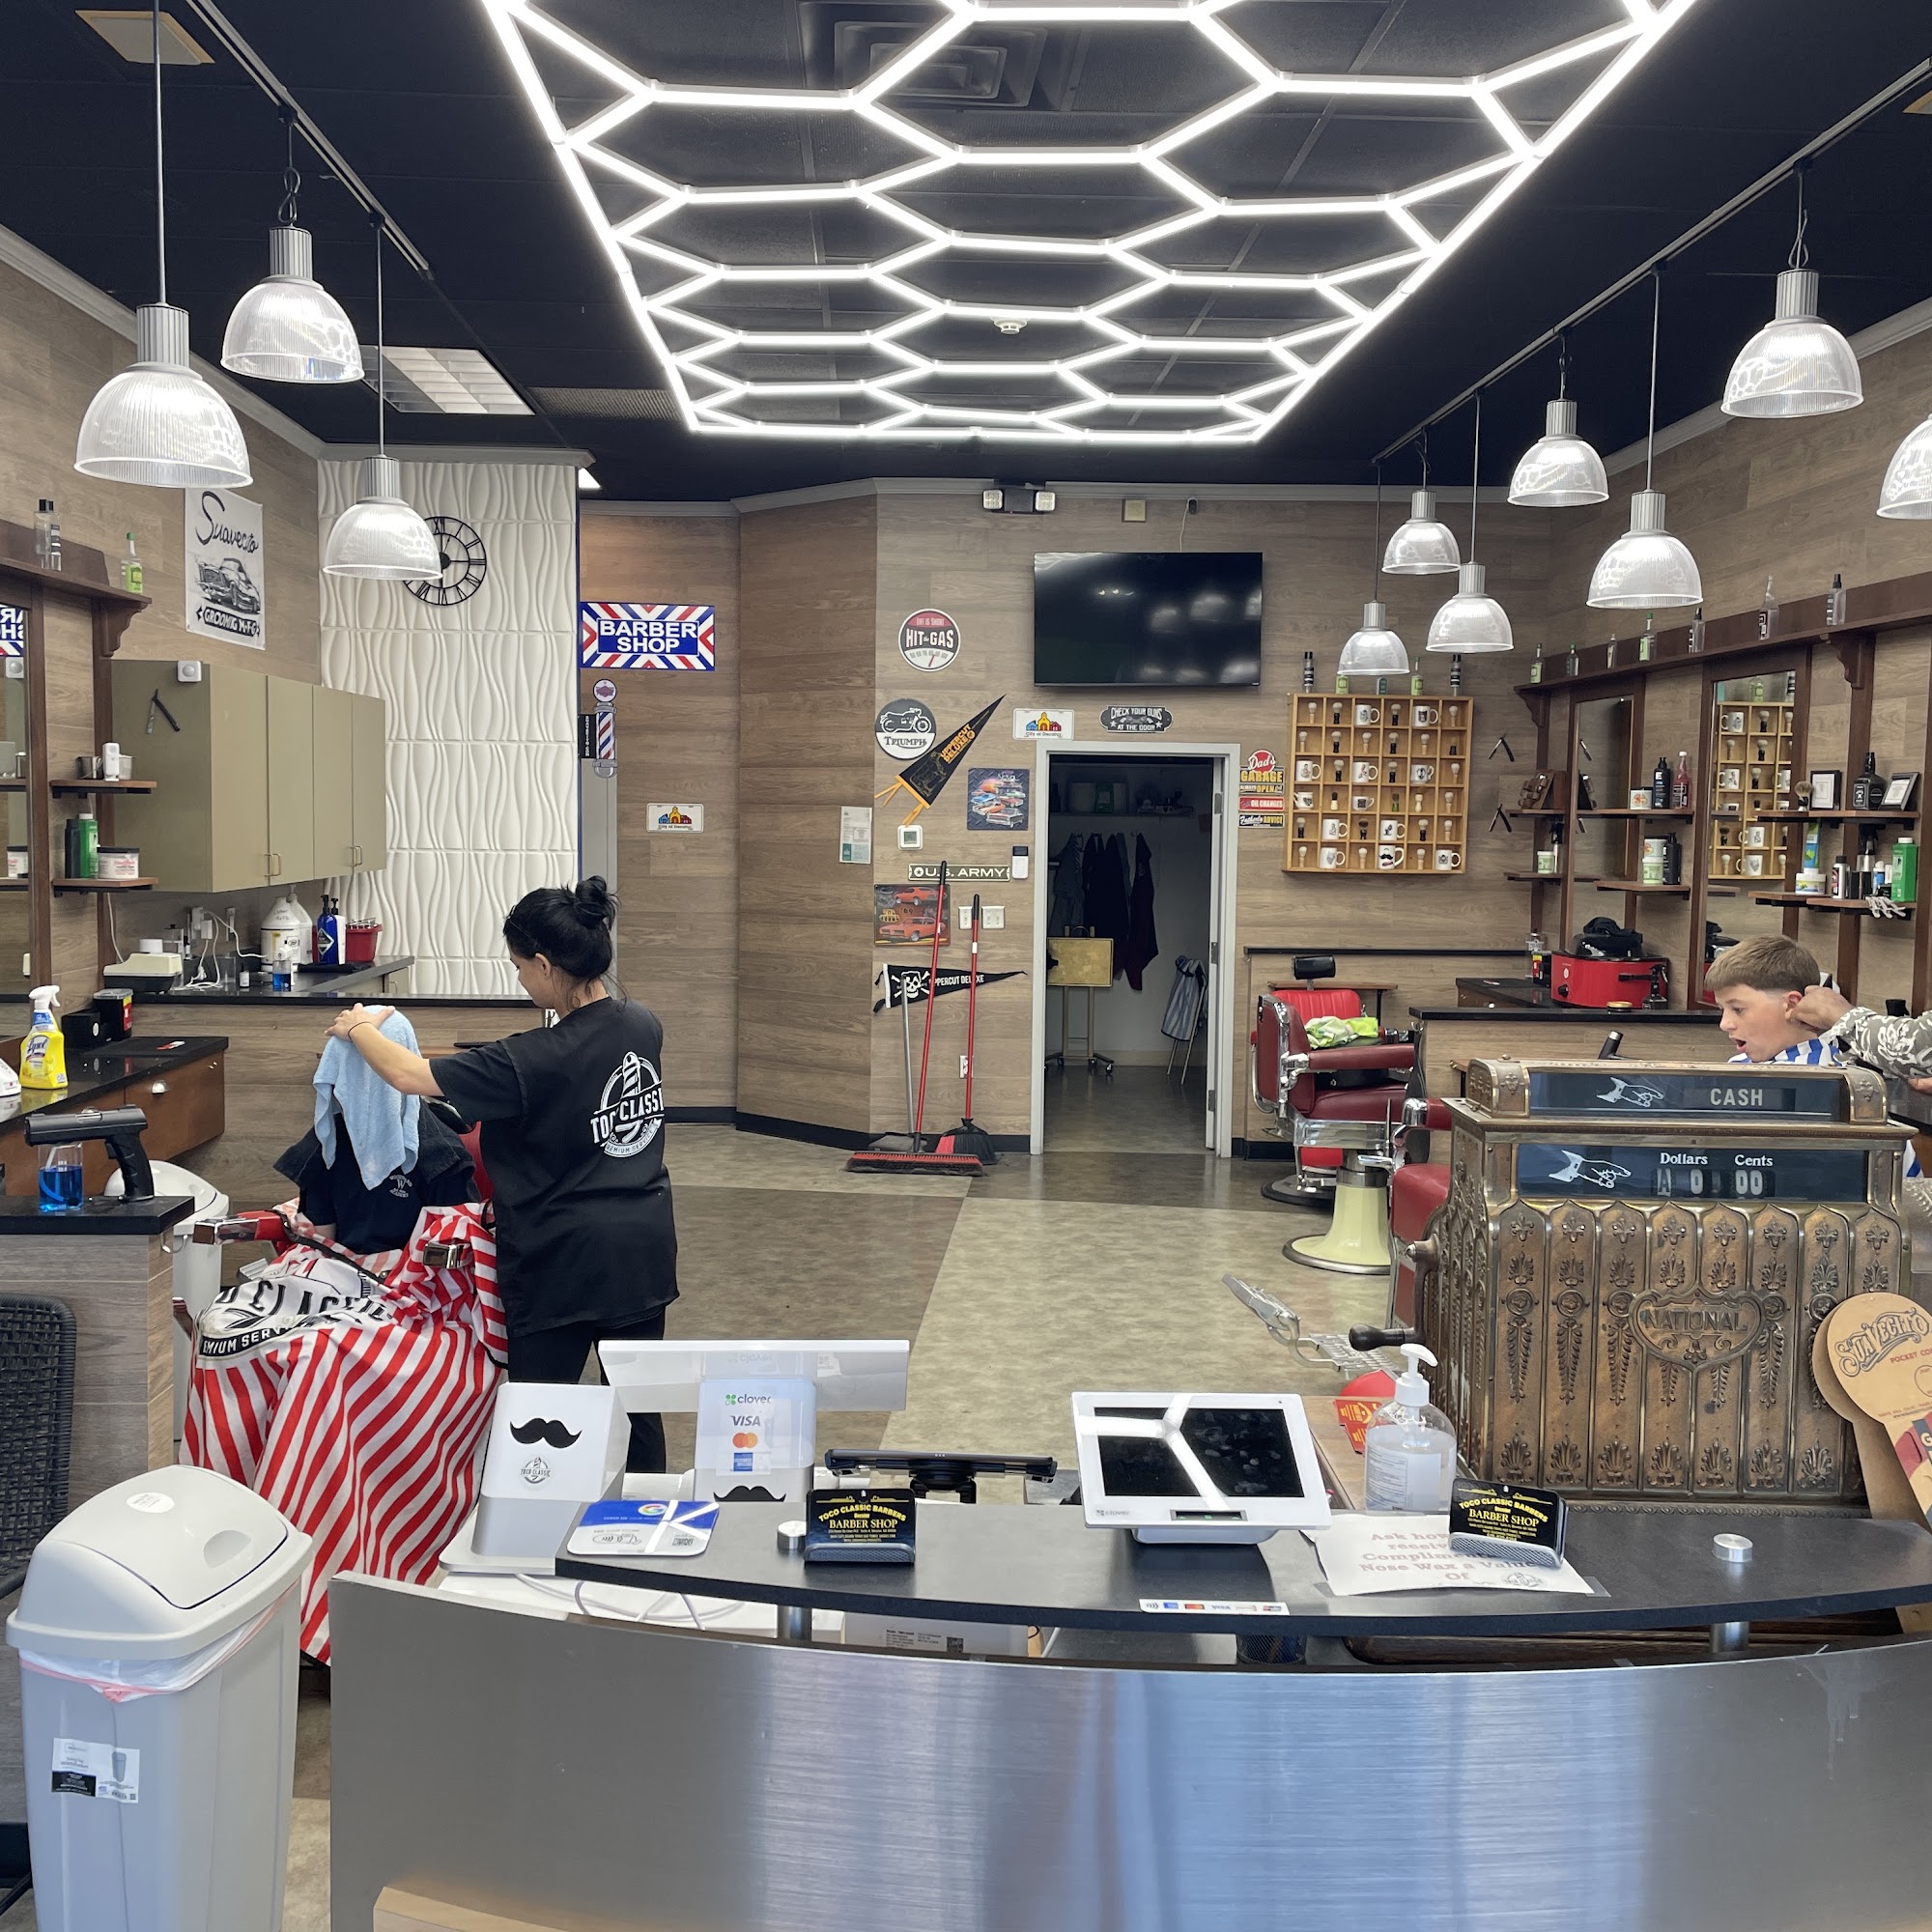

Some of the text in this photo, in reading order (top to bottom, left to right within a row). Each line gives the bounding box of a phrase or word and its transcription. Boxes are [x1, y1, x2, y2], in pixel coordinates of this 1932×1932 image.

[195, 491, 260, 554] Suavecito
[599, 620, 697, 639] BARBER
[616, 638, 680, 653] SHOP
[906, 628, 924, 648] HIT
[929, 629, 954, 649] GAS
[1111, 707, 1163, 721] CHECK YOUR GUNS
[884, 735, 927, 748] TRIUMPH
[940, 724, 972, 757] UPPERCUT
[943, 734, 969, 762] DELUXE
[1240, 770, 1283, 782] GARAGE
[1256, 784, 1275, 793] OPEN
[957, 867, 1006, 877] ARMY
[960, 974, 985, 984] DELXE
[27, 1037, 48, 1055] Lysol
[1709, 1088, 1763, 1106] CASH
[619, 1088, 665, 1121] CLASSI
[1660, 1152, 1709, 1165] Dollars
[1734, 1154, 1774, 1167] Cents
[1690, 1169, 1703, 1194] 0
[1735, 1169, 1764, 1195] 00
[1643, 1309, 1748, 1333] NATIONAL
[203, 1336, 238, 1354] EMIUM
[1834, 1307, 1930, 1378] SUAVECITO
[1889, 1352, 1918, 1364] POCKET
[737, 1394, 771, 1404] clover
[730, 1415, 761, 1427] VISA
[818, 1509, 840, 1522] TOCO
[839, 1504, 872, 1515] CLASSIC
[872, 1504, 907, 1522] BARBERS
[1459, 1498, 1481, 1510] TOCO
[1482, 1497, 1514, 1508] CLASSIC
[1514, 1501, 1548, 1523] BARBERS
[829, 1519, 898, 1529] BARBER SHOP
[1468, 1508, 1510, 1523] BARBER
[1510, 1514, 1540, 1527] SHOP
[1371, 1532, 1406, 1541] Ask
[1388, 1542, 1449, 1550] receiv
[1358, 1561, 1409, 1572] Nose
[1411, 1562, 1459, 1571] Wax
[1479, 1560, 1537, 1570] Value
[1444, 1572, 1471, 1581] Of
